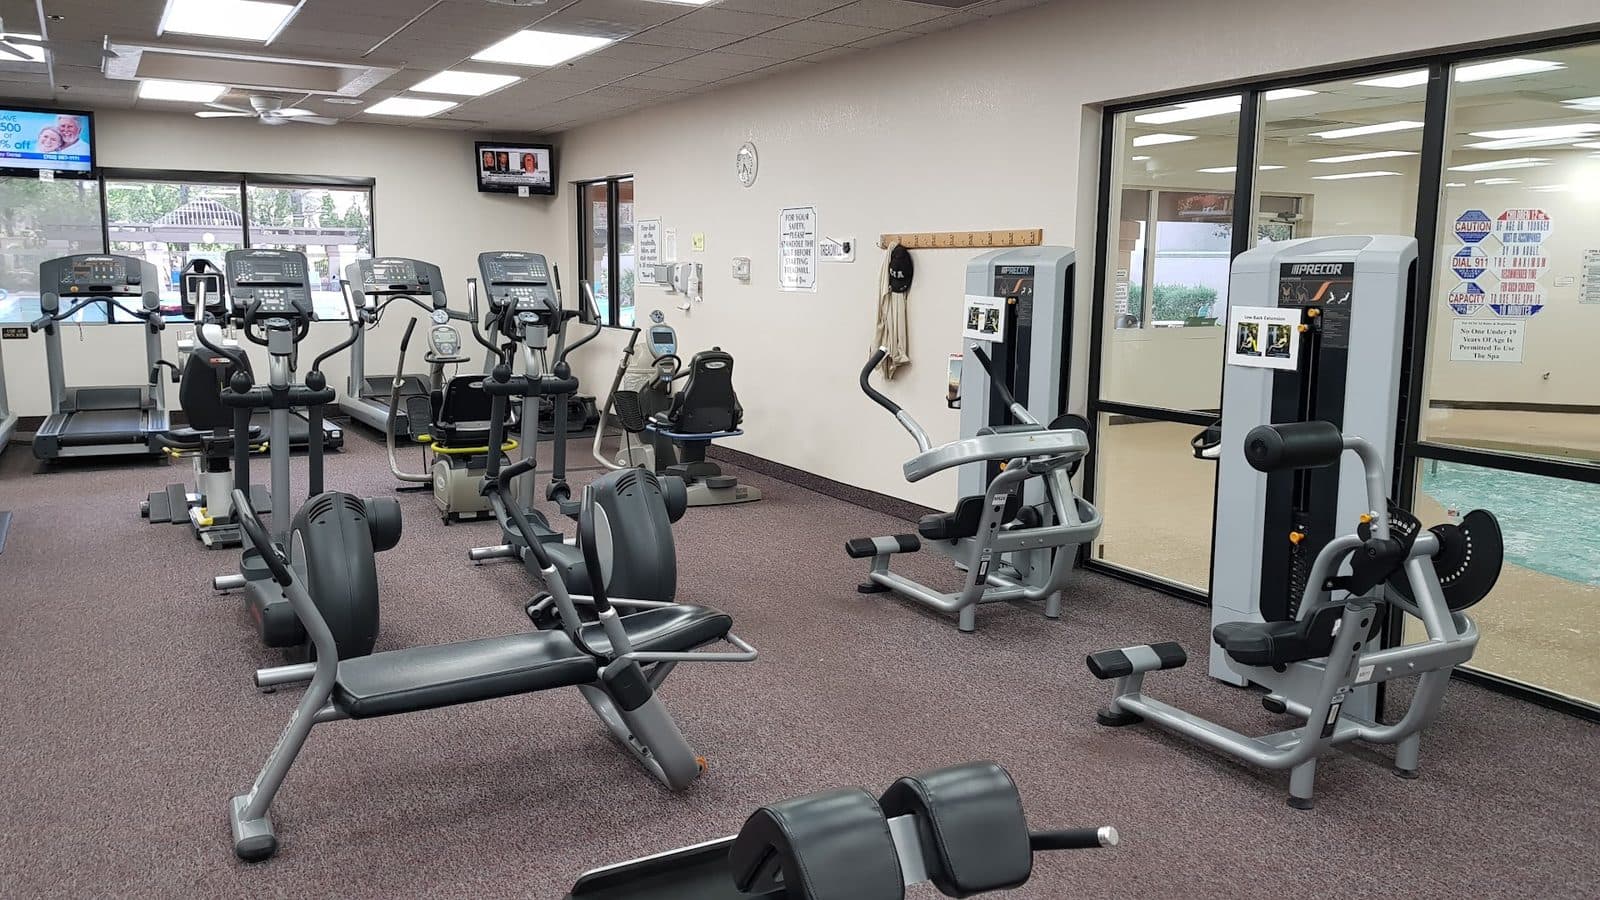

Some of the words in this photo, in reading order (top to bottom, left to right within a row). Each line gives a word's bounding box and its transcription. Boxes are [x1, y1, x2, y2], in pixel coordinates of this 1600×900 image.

[14, 140, 31, 150] off
[796, 213, 809, 221] YOUR
[1455, 221, 1492, 231] CAUTION
[789, 231, 805, 239] PLEASE
[1452, 257, 1471, 267] DIAL
[1475, 257, 1488, 267] 911
[1298, 264, 1343, 275] PRECOR
[1449, 294, 1485, 304] CAPACITY
